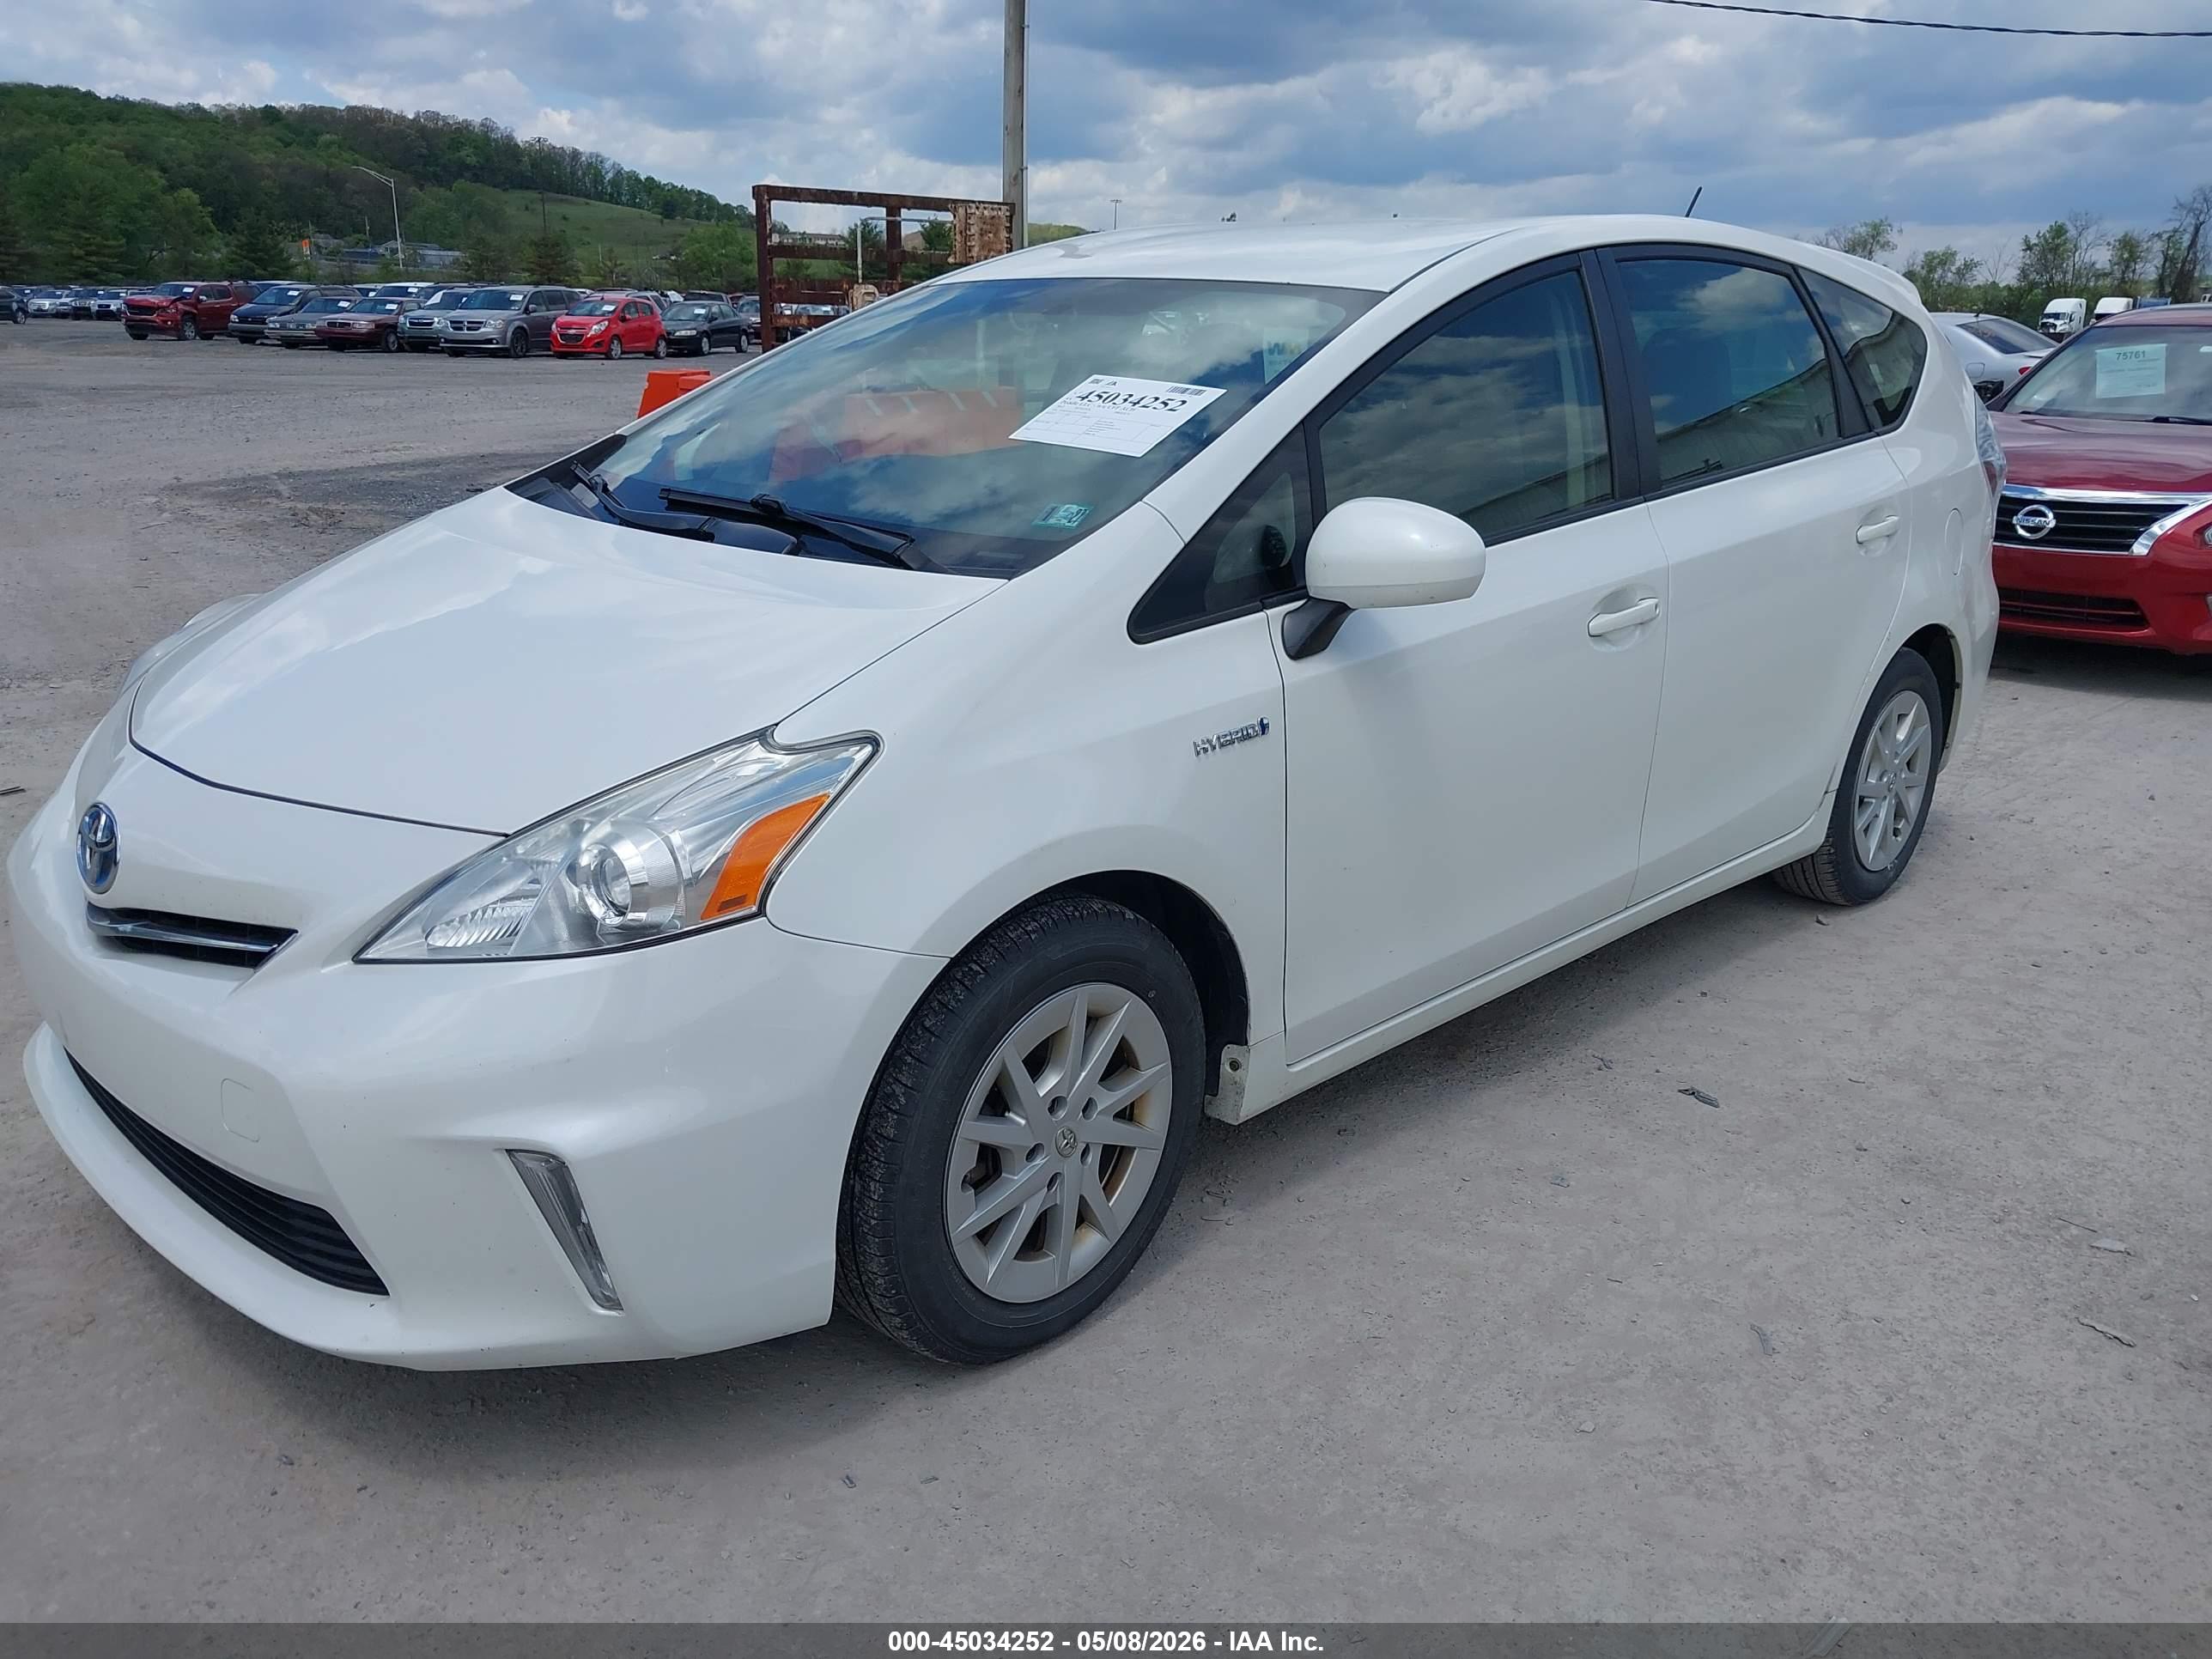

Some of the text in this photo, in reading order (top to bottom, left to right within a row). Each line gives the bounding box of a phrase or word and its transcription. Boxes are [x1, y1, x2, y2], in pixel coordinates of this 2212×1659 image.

[1076, 390, 1188, 412] 45034252
[2018, 517, 2051, 526] NISSAN
[1193, 723, 1259, 757] HYBRID
